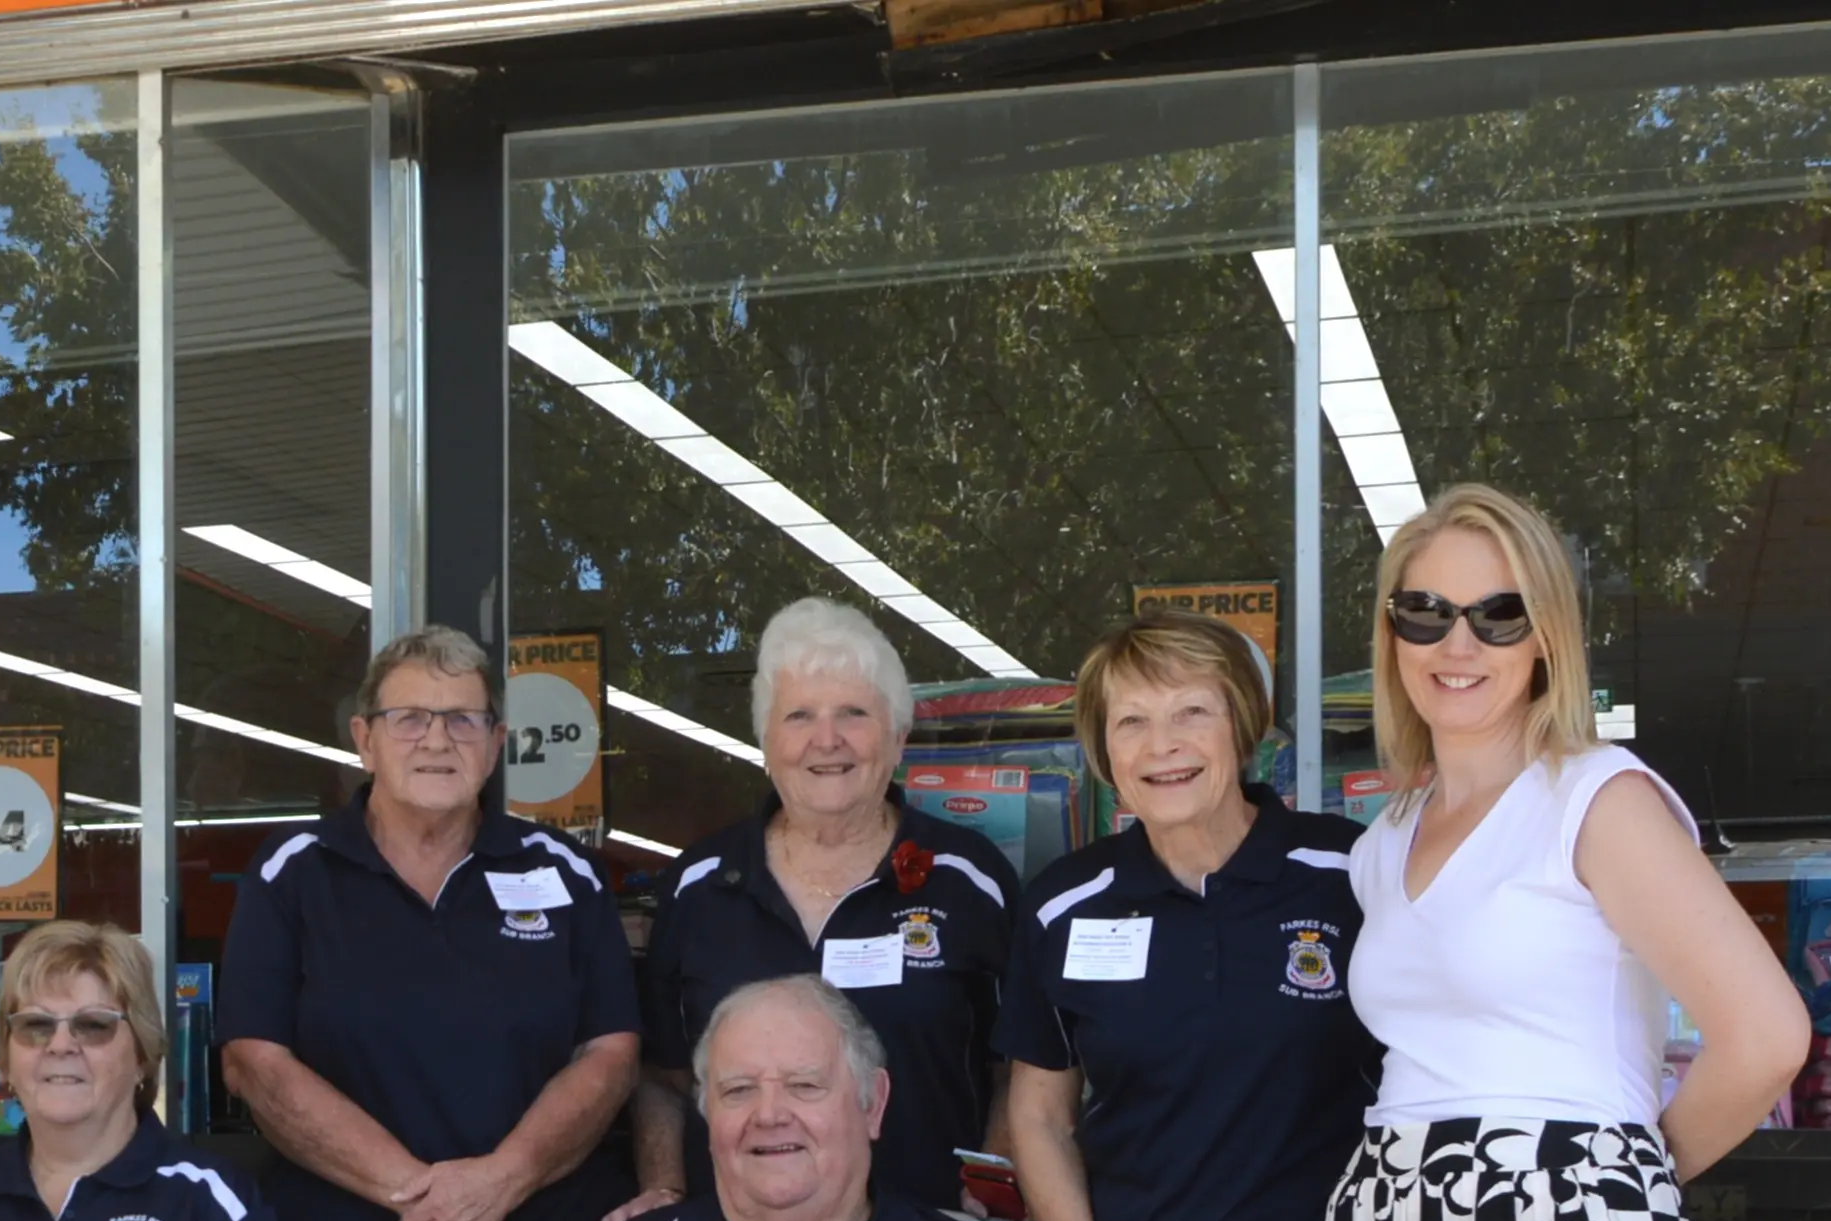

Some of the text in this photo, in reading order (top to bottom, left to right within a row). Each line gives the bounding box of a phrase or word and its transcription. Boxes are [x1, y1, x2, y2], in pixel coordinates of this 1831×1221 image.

[1199, 592, 1274, 615] PRICE
[526, 641, 597, 666] PRICE
[507, 722, 581, 765] 12.50
[16, 900, 53, 912] LASTS
[1279, 919, 1341, 938] PARKES RSL
[906, 959, 945, 968] BRANCH
[1278, 983, 1345, 1000] SUB BRANCH
